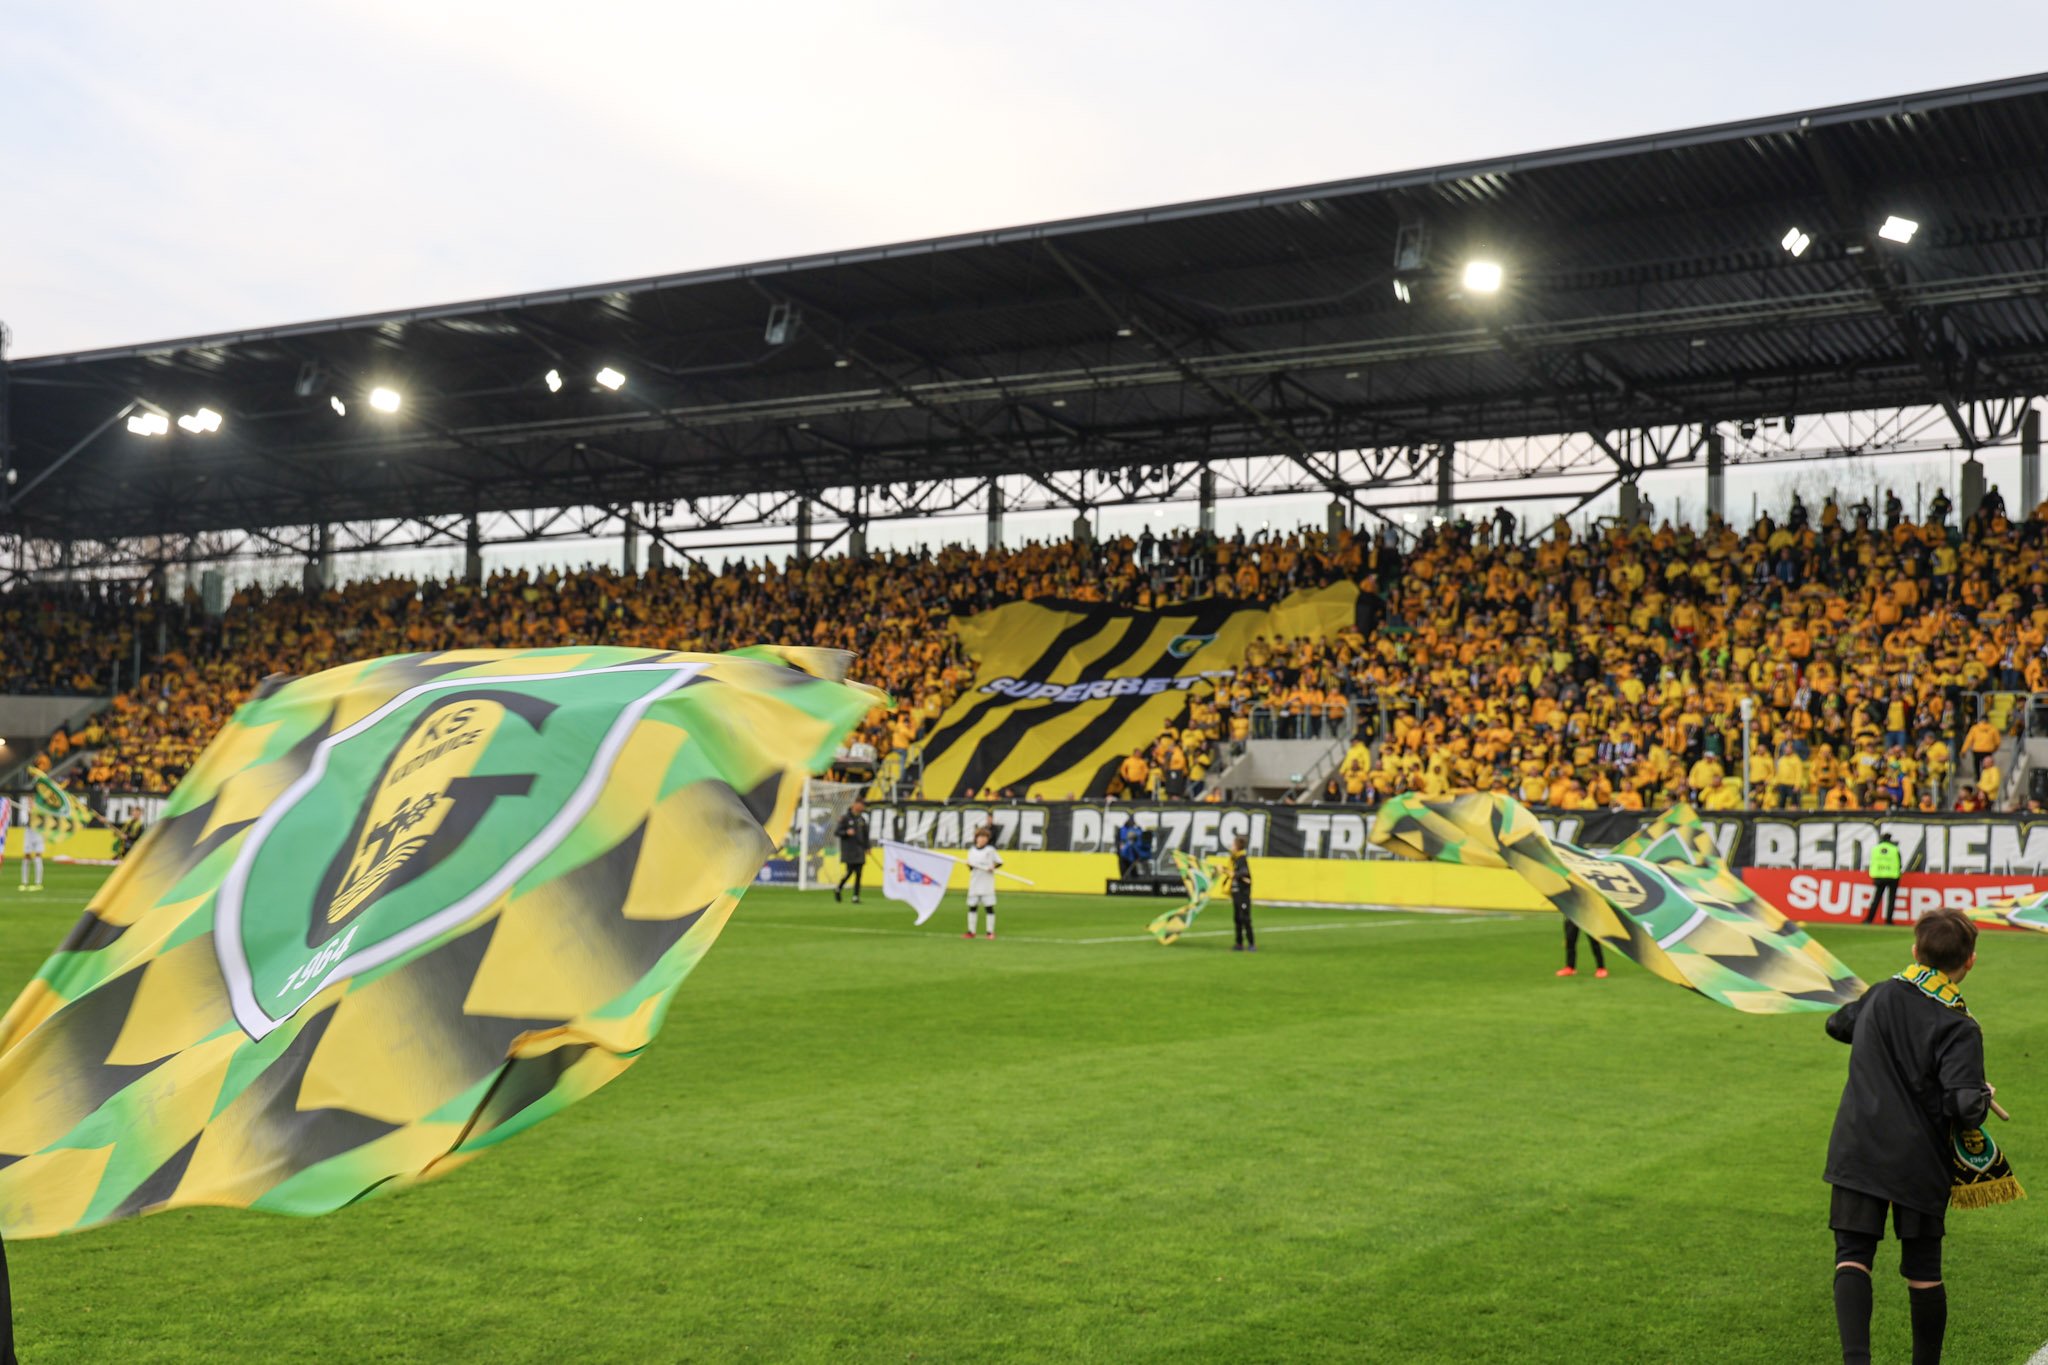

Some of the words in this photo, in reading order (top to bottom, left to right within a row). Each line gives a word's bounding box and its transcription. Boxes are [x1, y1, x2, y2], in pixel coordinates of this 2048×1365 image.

[979, 675, 1200, 703] SUPERBET
[416, 706, 478, 750] KS
[1786, 875, 2035, 922] SUPERBET
[275, 924, 360, 998] 1964
